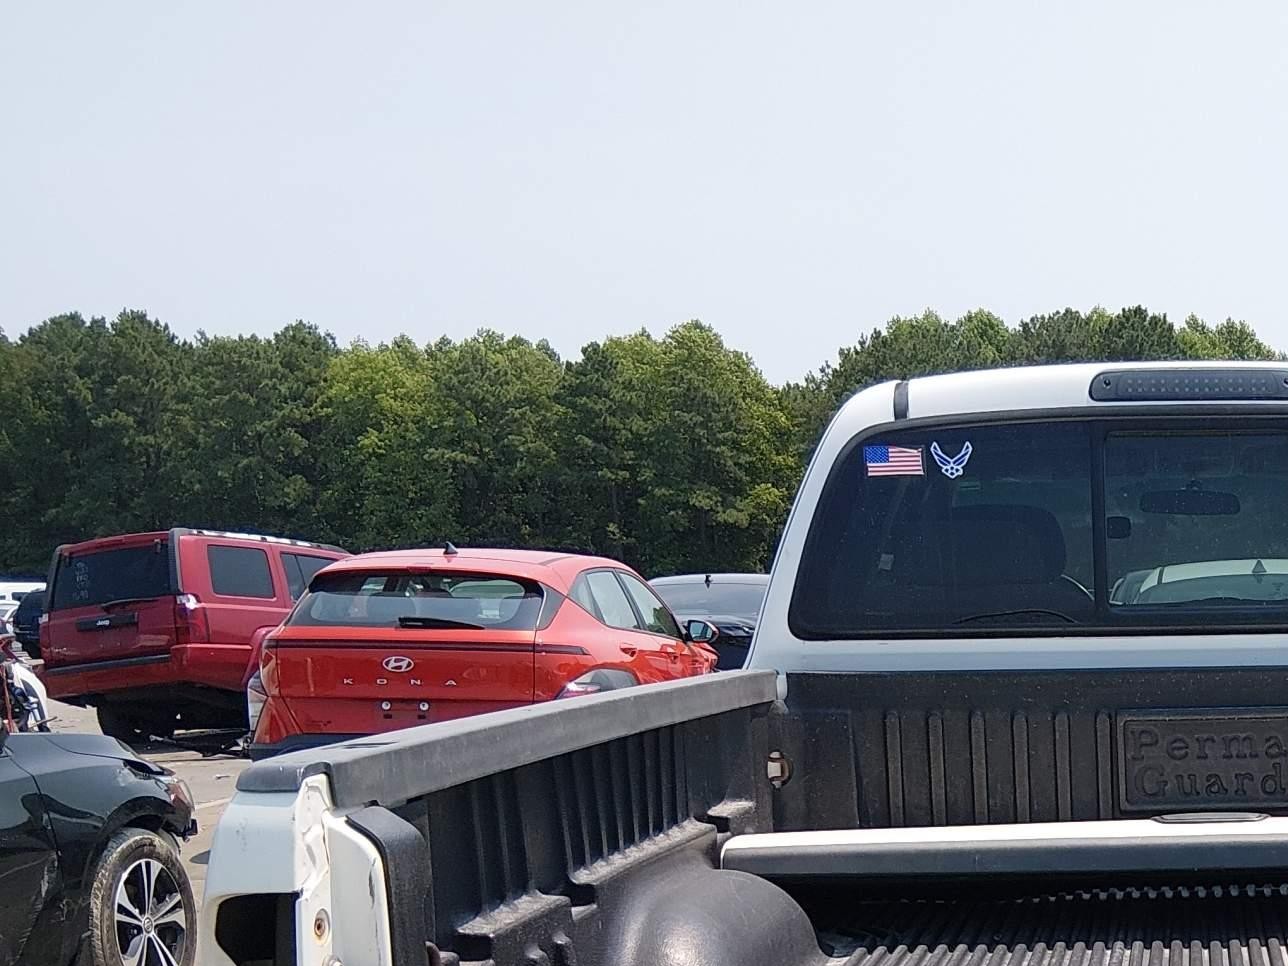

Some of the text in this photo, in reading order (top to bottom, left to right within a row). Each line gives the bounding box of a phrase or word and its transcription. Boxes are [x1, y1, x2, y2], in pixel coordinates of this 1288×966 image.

[343, 678, 457, 686] KONA
[1130, 728, 1288, 761] Perma
[1134, 763, 1287, 797] Guard
